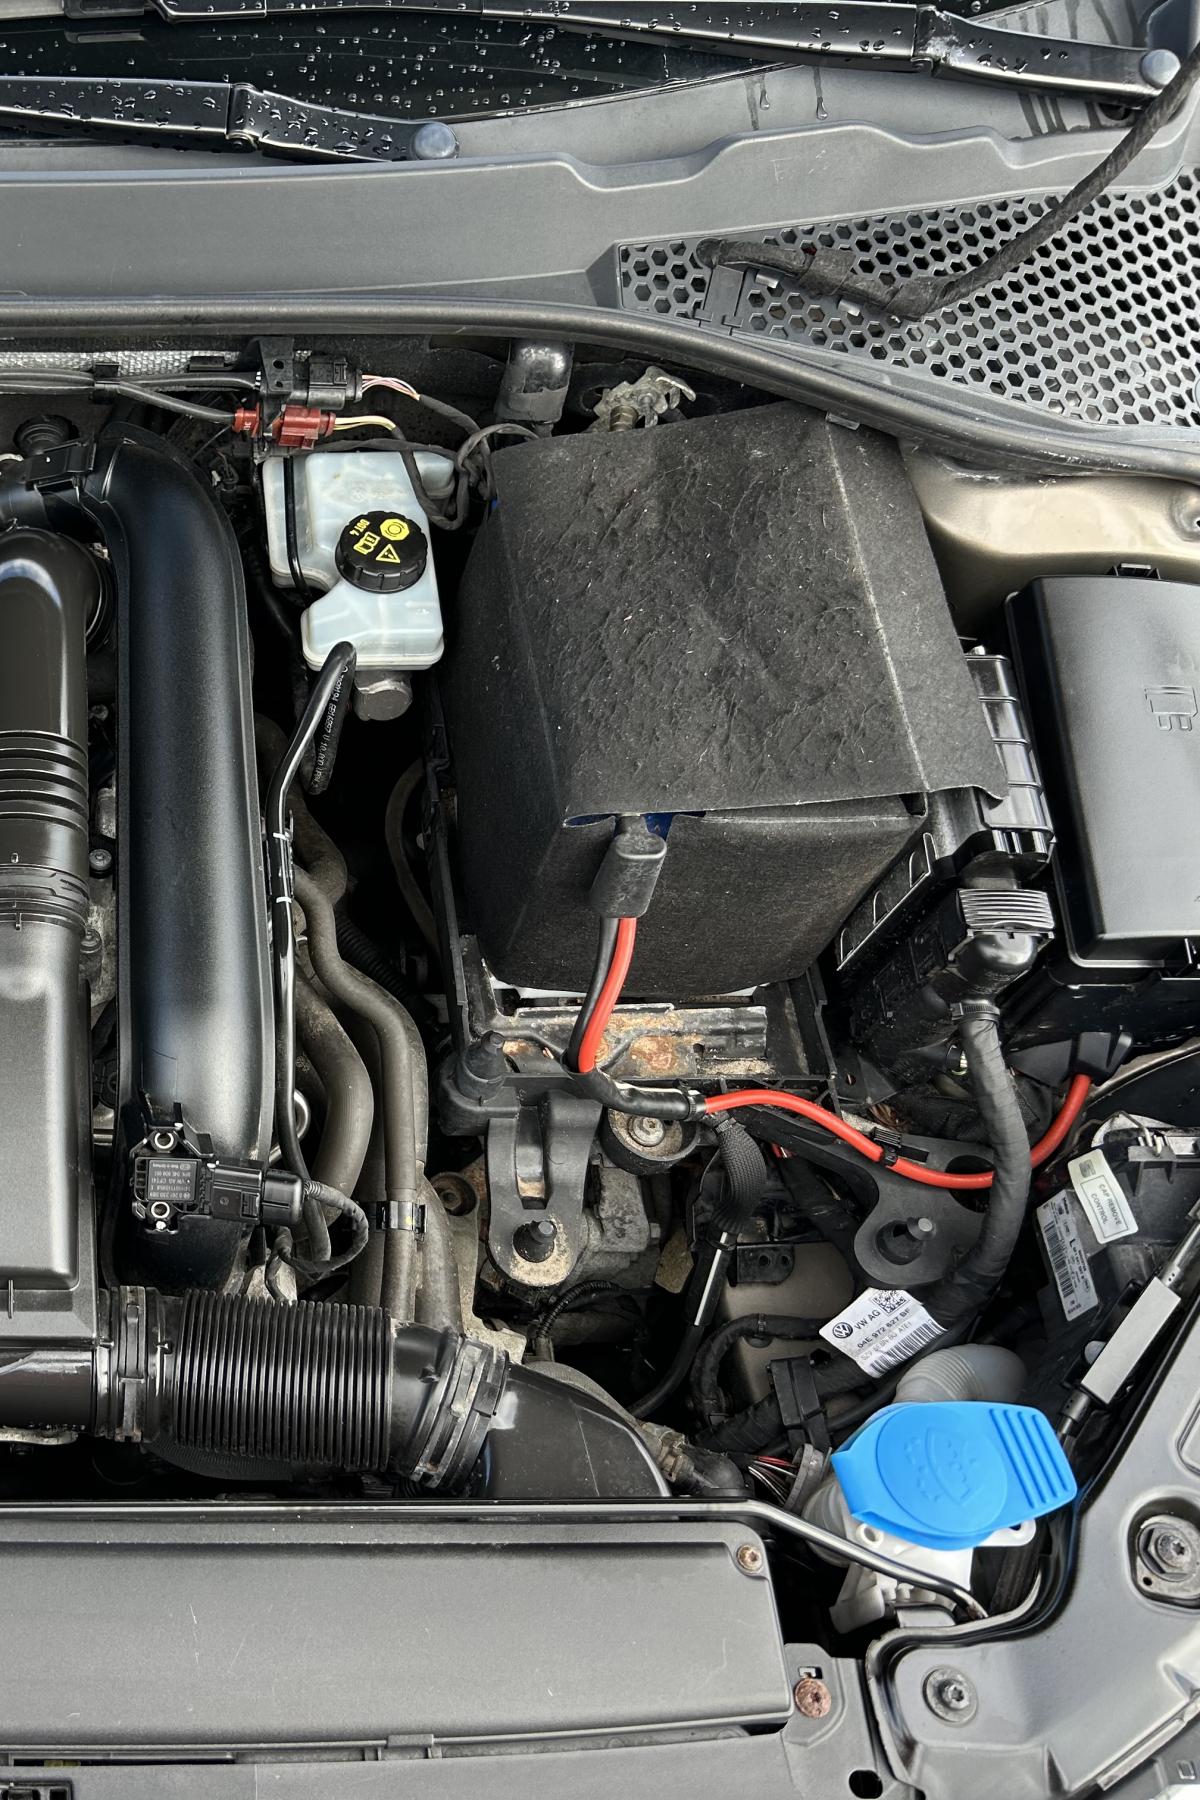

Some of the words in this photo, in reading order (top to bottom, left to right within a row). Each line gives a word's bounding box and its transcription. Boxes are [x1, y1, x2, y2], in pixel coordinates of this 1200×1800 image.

[1091, 1193, 1108, 1225] CONTROL
[1099, 1183, 1109, 1197] CAP
[1108, 1199, 1122, 1225] REMOVE
[1070, 1238, 1076, 1248] L
[854, 1318, 869, 1331] VW
[868, 1309, 881, 1321] AG
[857, 1337, 873, 1349] 04E
[872, 1326, 887, 1339] 972
